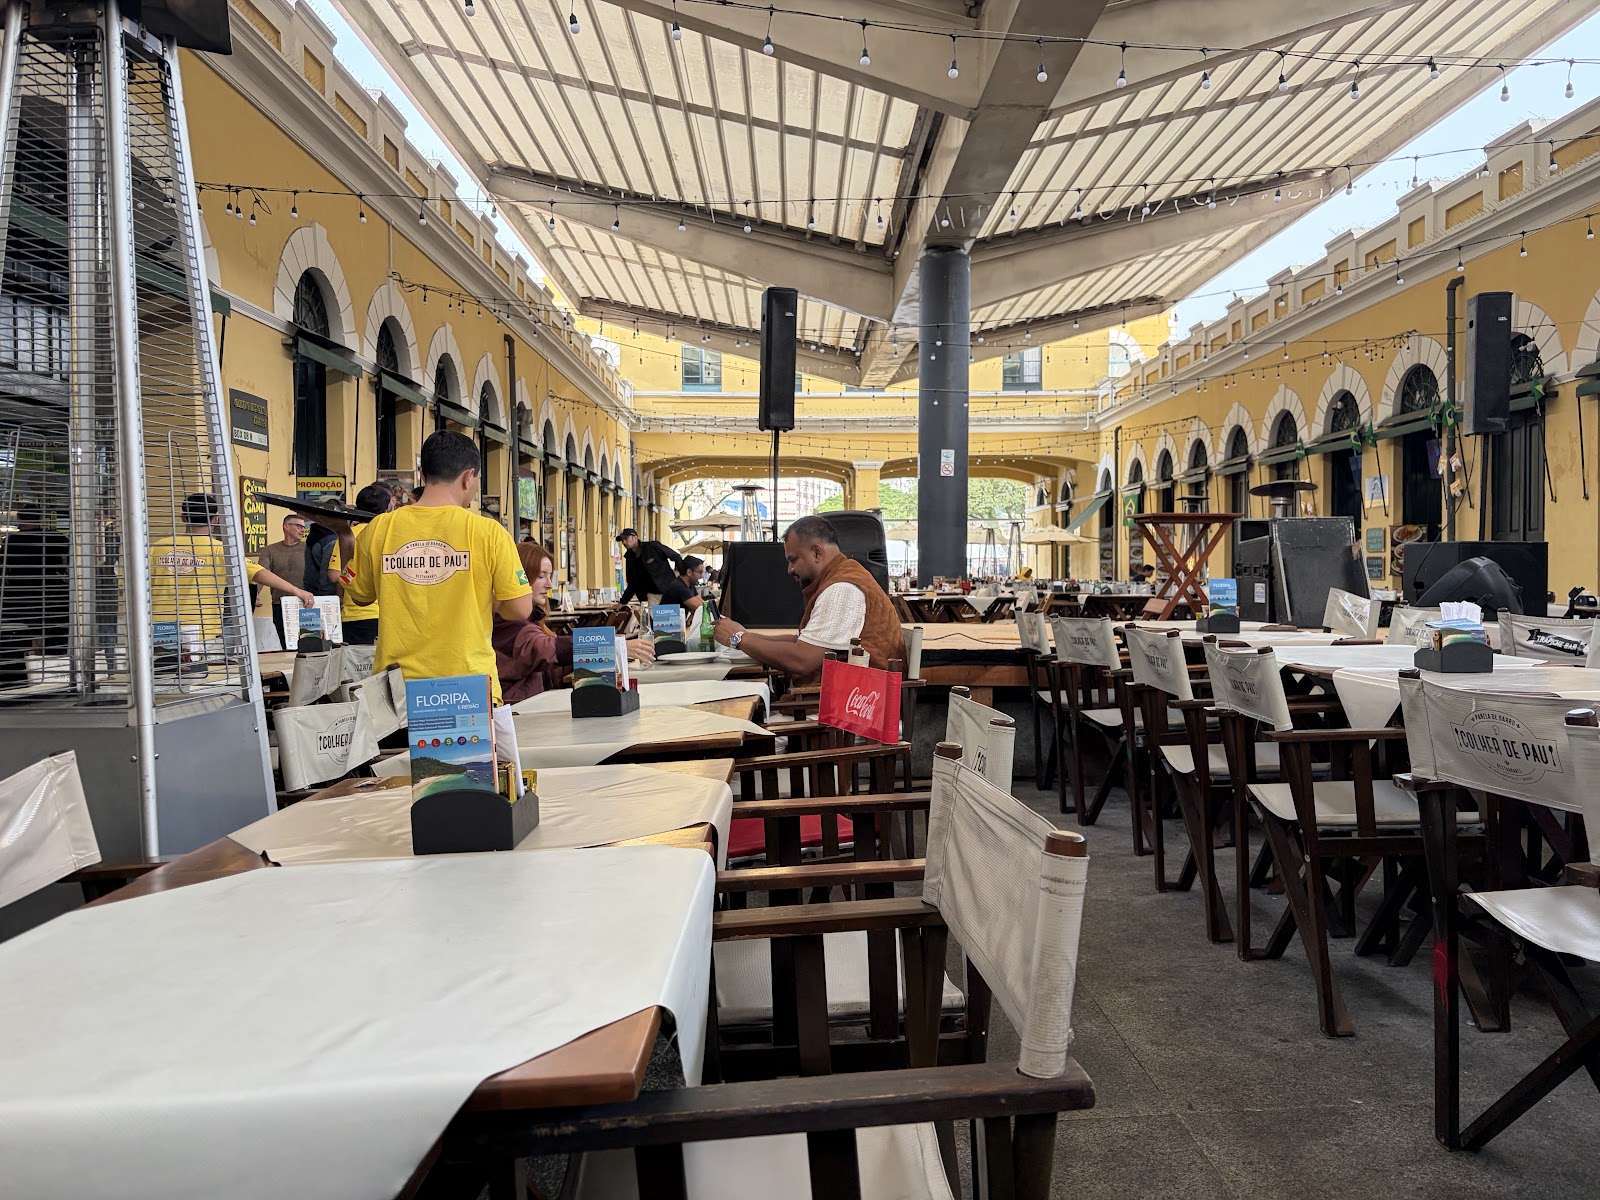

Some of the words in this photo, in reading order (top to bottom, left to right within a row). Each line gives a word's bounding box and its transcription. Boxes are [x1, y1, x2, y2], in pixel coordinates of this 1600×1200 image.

[297, 481, 342, 490] PROMOÇÃO
[244, 497, 265, 515] CANA
[244, 516, 267, 534] PASTEL
[248, 534, 257, 553] 14
[390, 556, 426, 570] COLHER
[429, 556, 441, 568] DE
[444, 555, 462, 568] PAU
[579, 635, 606, 643] FLORIPA
[416, 692, 471, 707] FLORIPA
[1499, 715, 1516, 726] BARRO
[323, 734, 349, 749] COLHER
[1460, 730, 1502, 755] COLHER
[1503, 739, 1521, 759] DE
[1522, 742, 1549, 765] PAU
